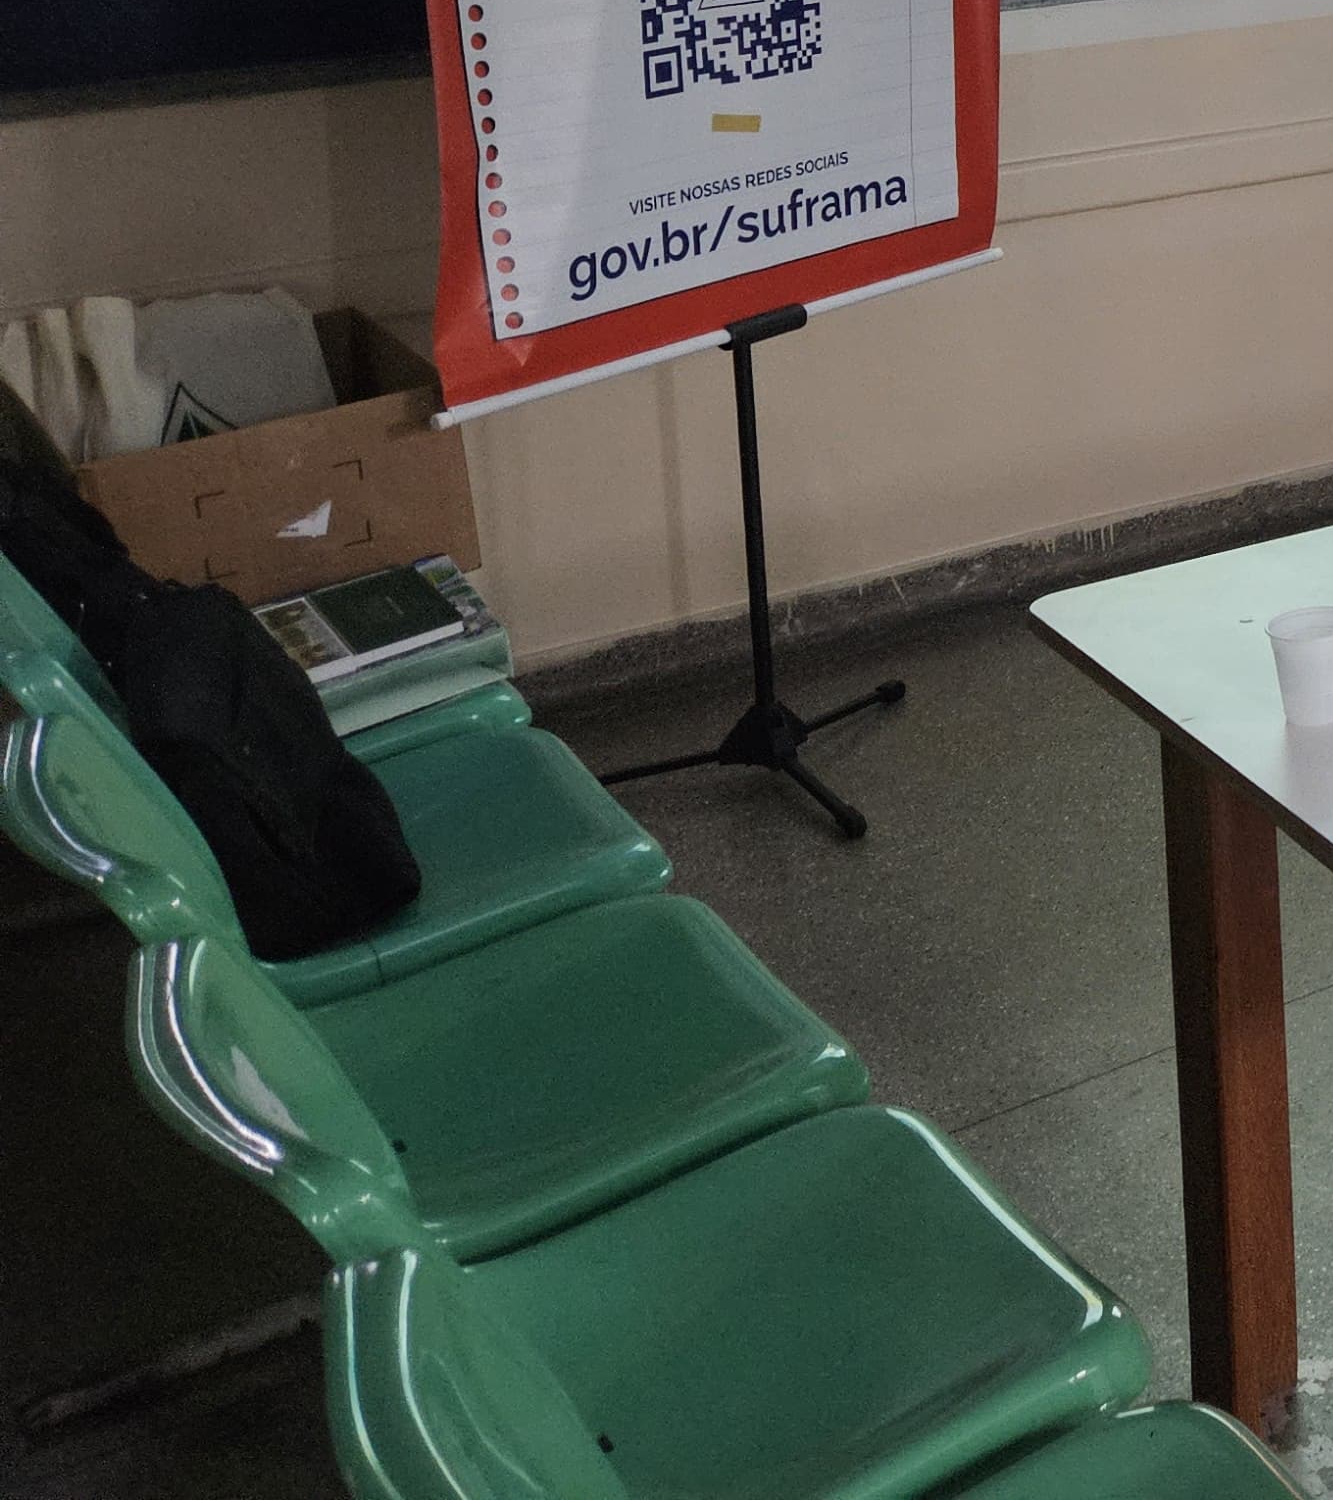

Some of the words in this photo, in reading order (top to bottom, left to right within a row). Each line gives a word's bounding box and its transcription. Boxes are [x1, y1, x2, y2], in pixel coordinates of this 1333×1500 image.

[629, 191, 677, 216] VISITE
[680, 176, 741, 202] NOSSAS
[745, 165, 792, 189] REDES
[795, 151, 849, 176] SOCIAIS
[568, 175, 908, 301] gov.br/suframa
